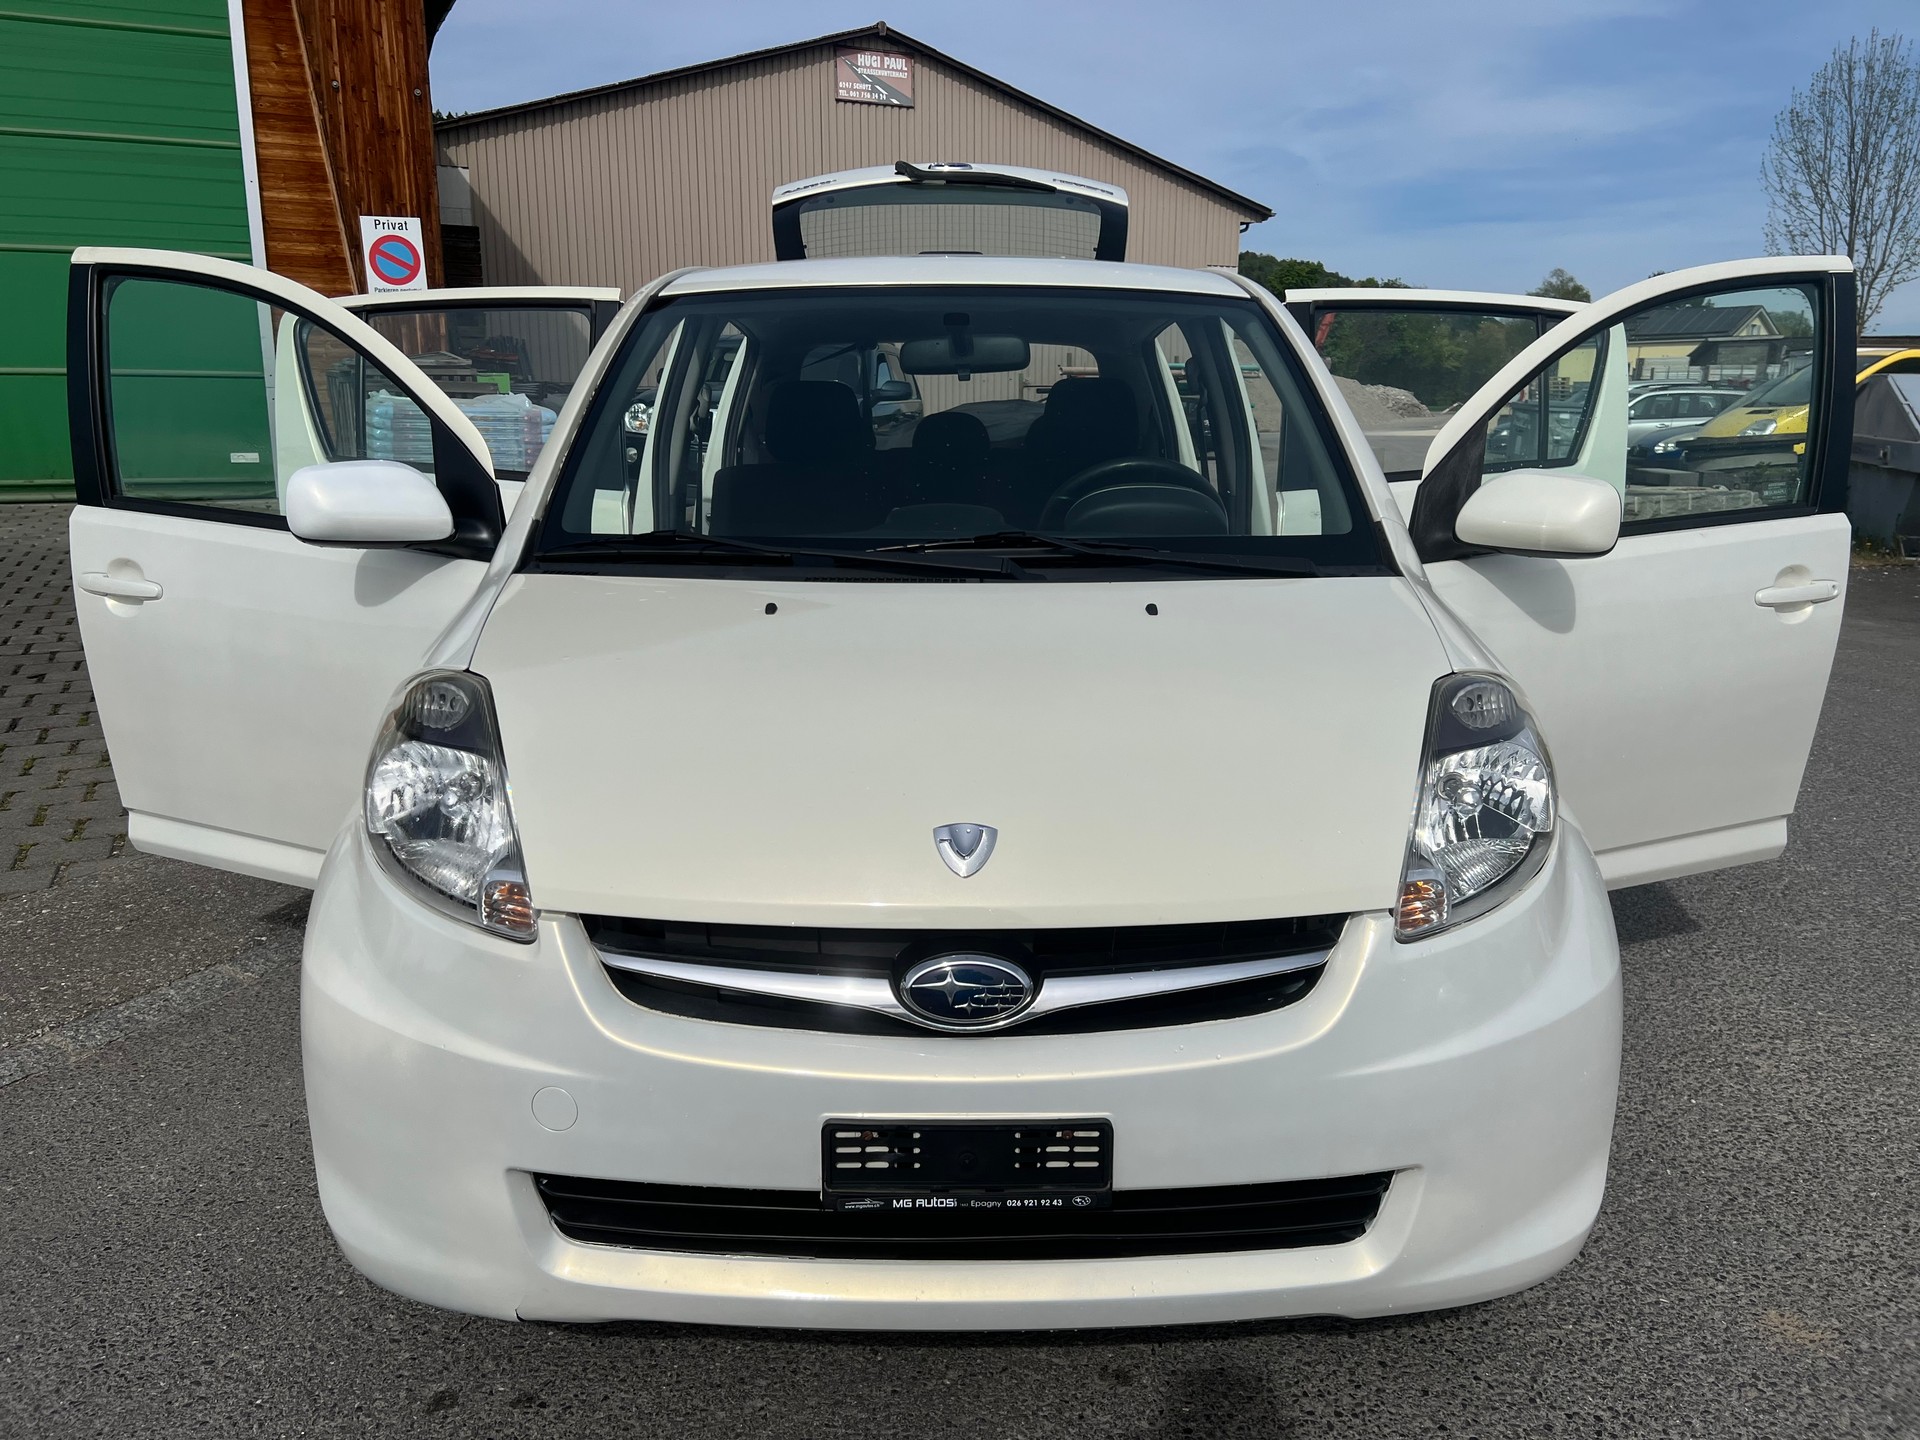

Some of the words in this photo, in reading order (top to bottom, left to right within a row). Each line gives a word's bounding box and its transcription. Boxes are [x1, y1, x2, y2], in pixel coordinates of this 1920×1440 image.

[857, 52, 880, 67] HÜGI
[884, 56, 907, 70] PAUL
[374, 218, 409, 231] Privat
[892, 1199, 913, 1208] MG
[970, 1199, 1002, 1208] Epagny
[1006, 1199, 1022, 1207] 026
[1023, 1199, 1038, 1207] 921
[1040, 1199, 1051, 1207] 92
[1052, 1198, 1063, 1206] 43
